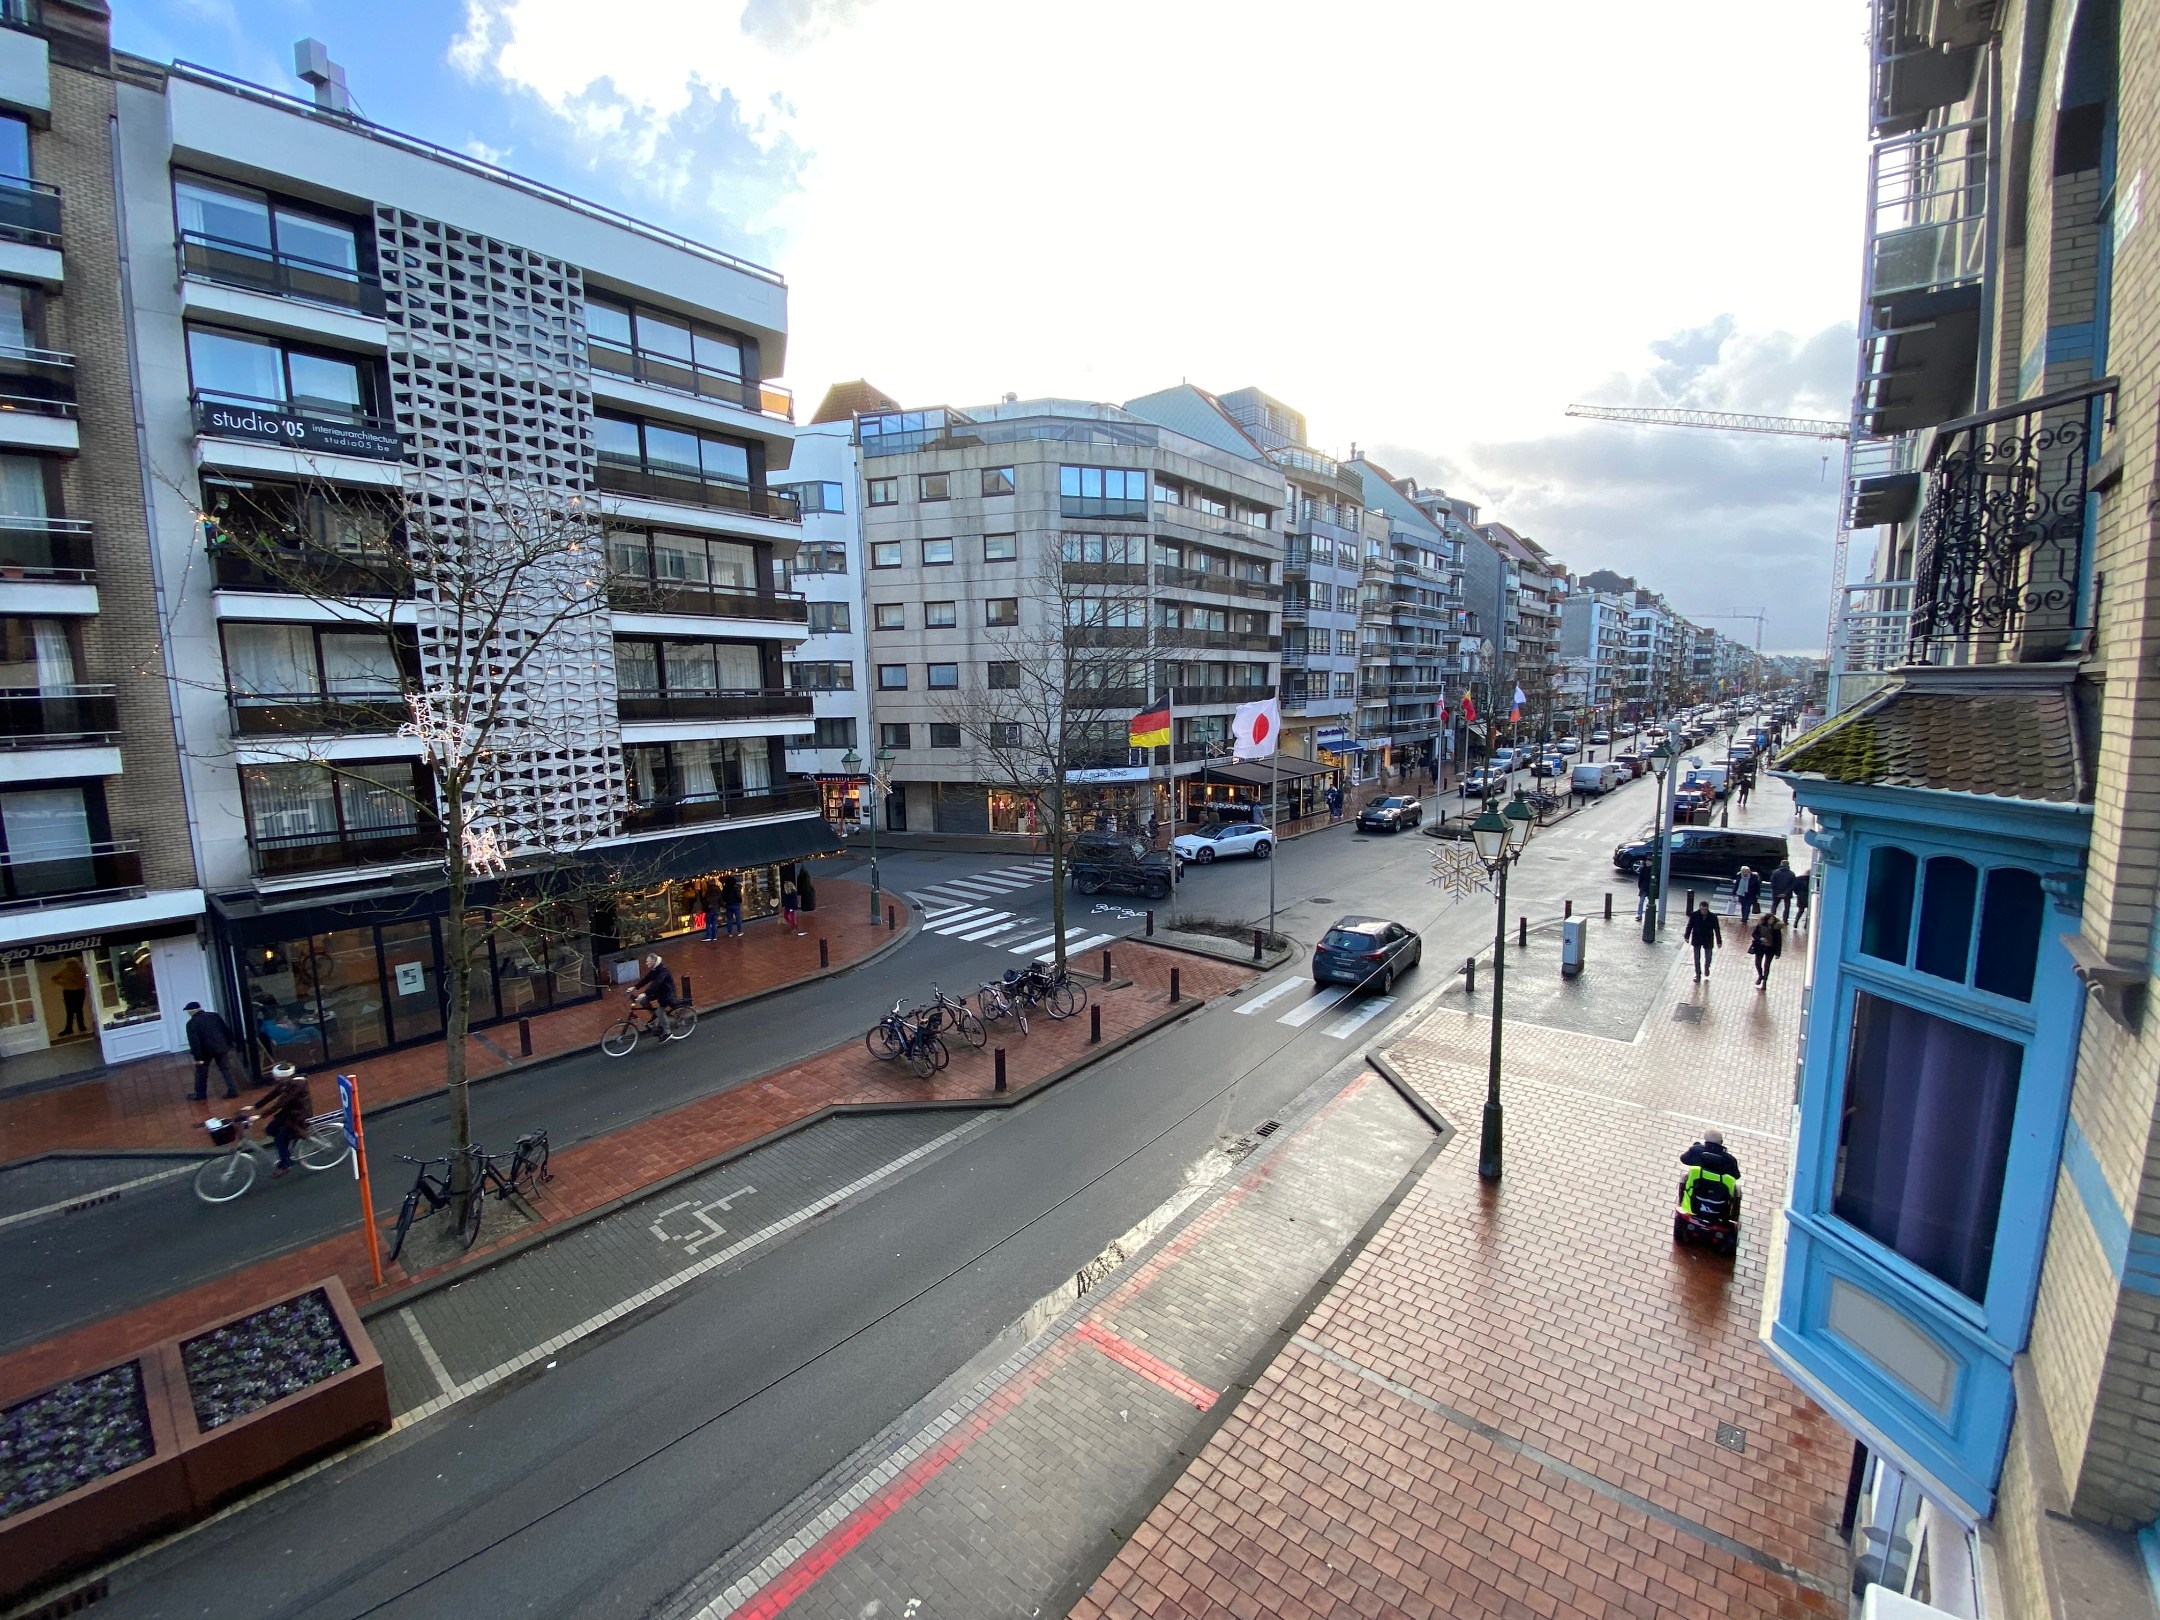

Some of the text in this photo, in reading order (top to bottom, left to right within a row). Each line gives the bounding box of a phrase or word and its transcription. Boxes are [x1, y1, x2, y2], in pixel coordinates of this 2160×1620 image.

[212, 412, 278, 434] studio
[312, 424, 399, 445] interieurarchitectuur
[324, 437, 390, 452] studio05.be
[1688, 773, 1696, 782] P
[0, 936, 102, 963] gio Danielli
